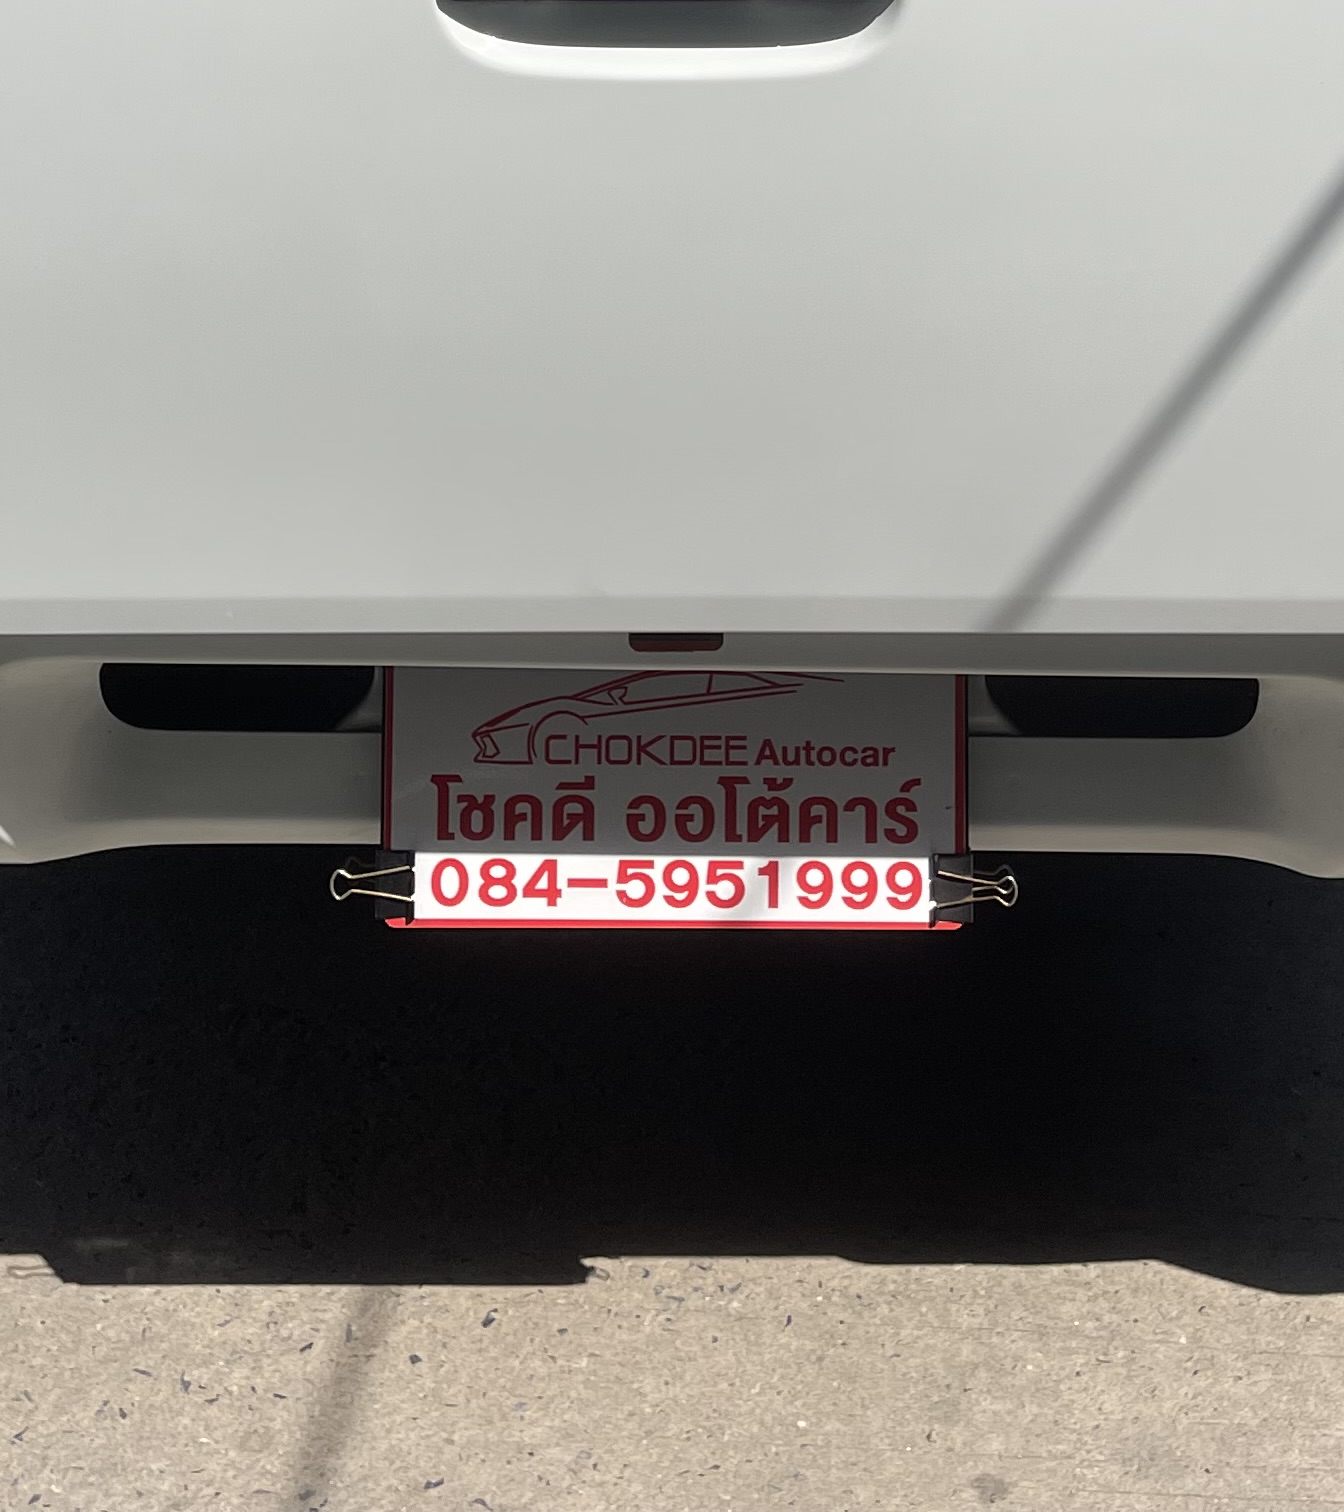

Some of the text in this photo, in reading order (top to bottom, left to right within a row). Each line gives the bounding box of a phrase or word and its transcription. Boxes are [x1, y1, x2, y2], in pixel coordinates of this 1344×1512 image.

[544, 734, 896, 768] CHOKDEE Autocar
[430, 774, 922, 845] โชคดี ออโต้คาร์
[430, 858, 922, 911] 084-5951999
